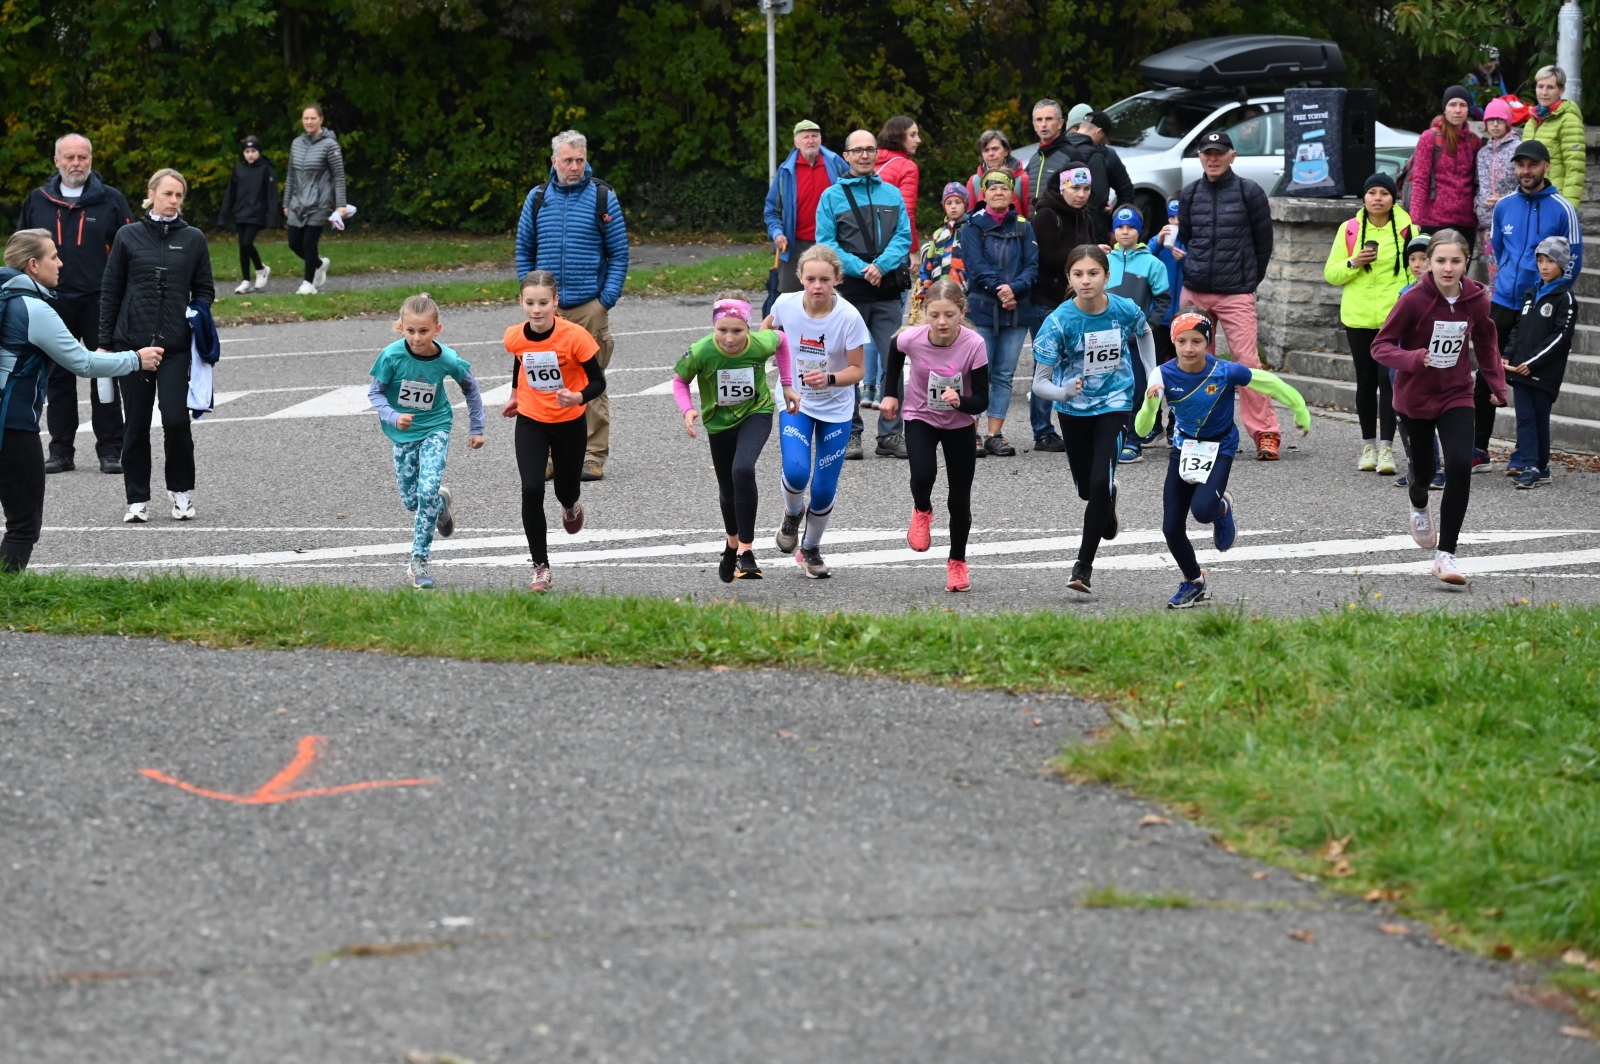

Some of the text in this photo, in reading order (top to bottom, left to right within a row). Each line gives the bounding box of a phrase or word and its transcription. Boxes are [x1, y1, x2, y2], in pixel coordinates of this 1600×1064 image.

[1432, 339, 1462, 354] 102
[1086, 349, 1119, 363] 165
[527, 369, 561, 381] 160
[400, 389, 433, 403] 210
[720, 385, 753, 397] 159
[824, 428, 842, 442] ATEX
[1181, 458, 1212, 472] 134
